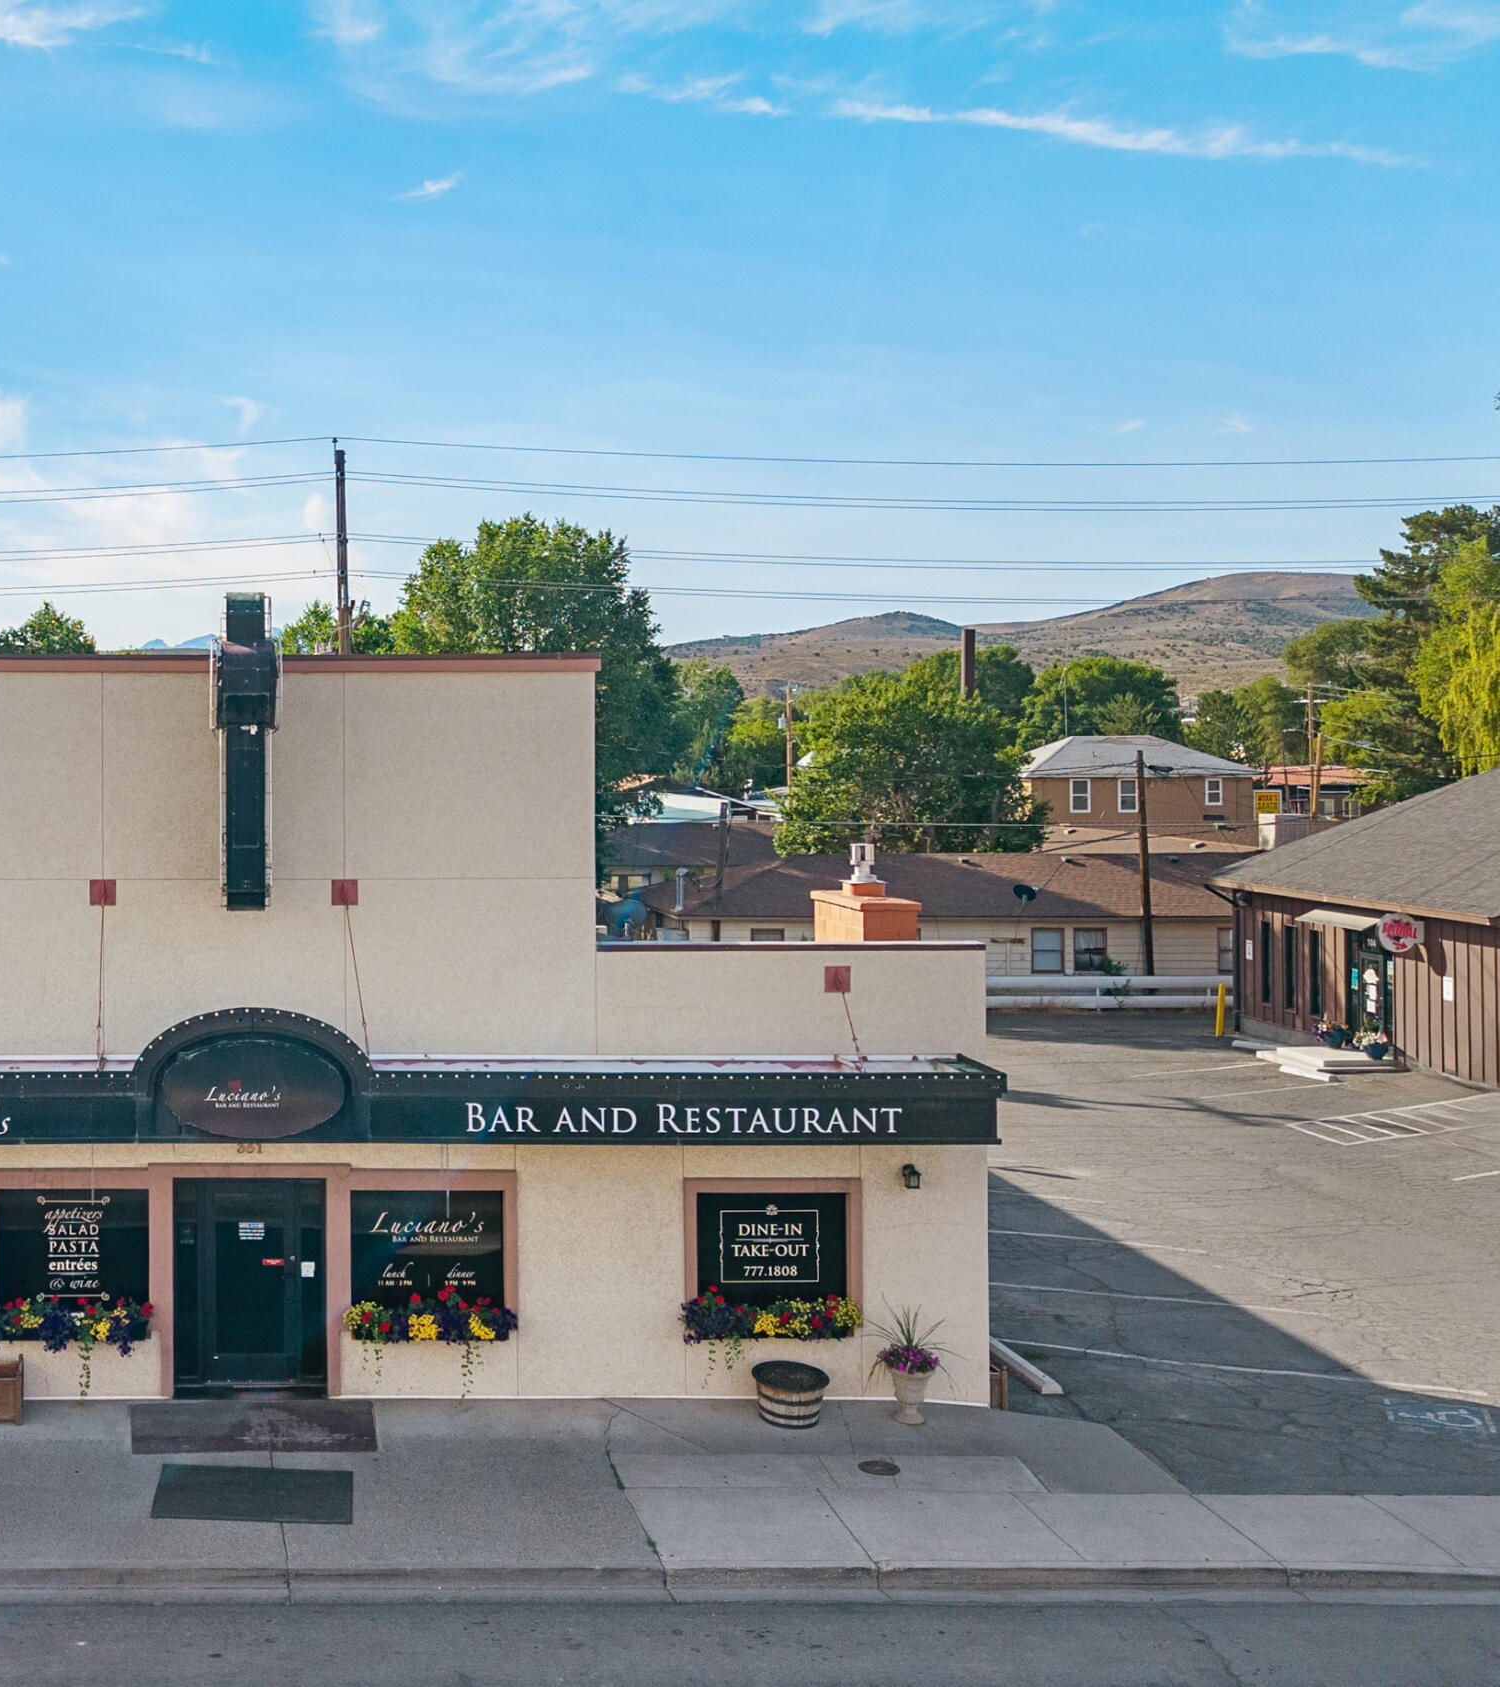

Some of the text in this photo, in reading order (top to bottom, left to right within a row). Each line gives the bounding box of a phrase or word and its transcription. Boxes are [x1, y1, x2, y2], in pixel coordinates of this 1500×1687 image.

[204, 1085, 282, 1102] Luciano's
[465, 1102, 903, 1134] BAR AND RESTAURANT
[43, 1207, 104, 1233] appetizers
[368, 1211, 485, 1234] Luciano's
[48, 1224, 99, 1235] SALAD
[738, 1223, 803, 1236] DINE-IN
[49, 1241, 99, 1253] PASTA
[730, 1244, 810, 1257] TAKE-OUT
[48, 1258, 99, 1271] entrées
[382, 1261, 415, 1279] lunch
[446, 1262, 477, 1279] dinner
[743, 1265, 798, 1277] 777.1808
[49, 1275, 100, 1290] & wine
